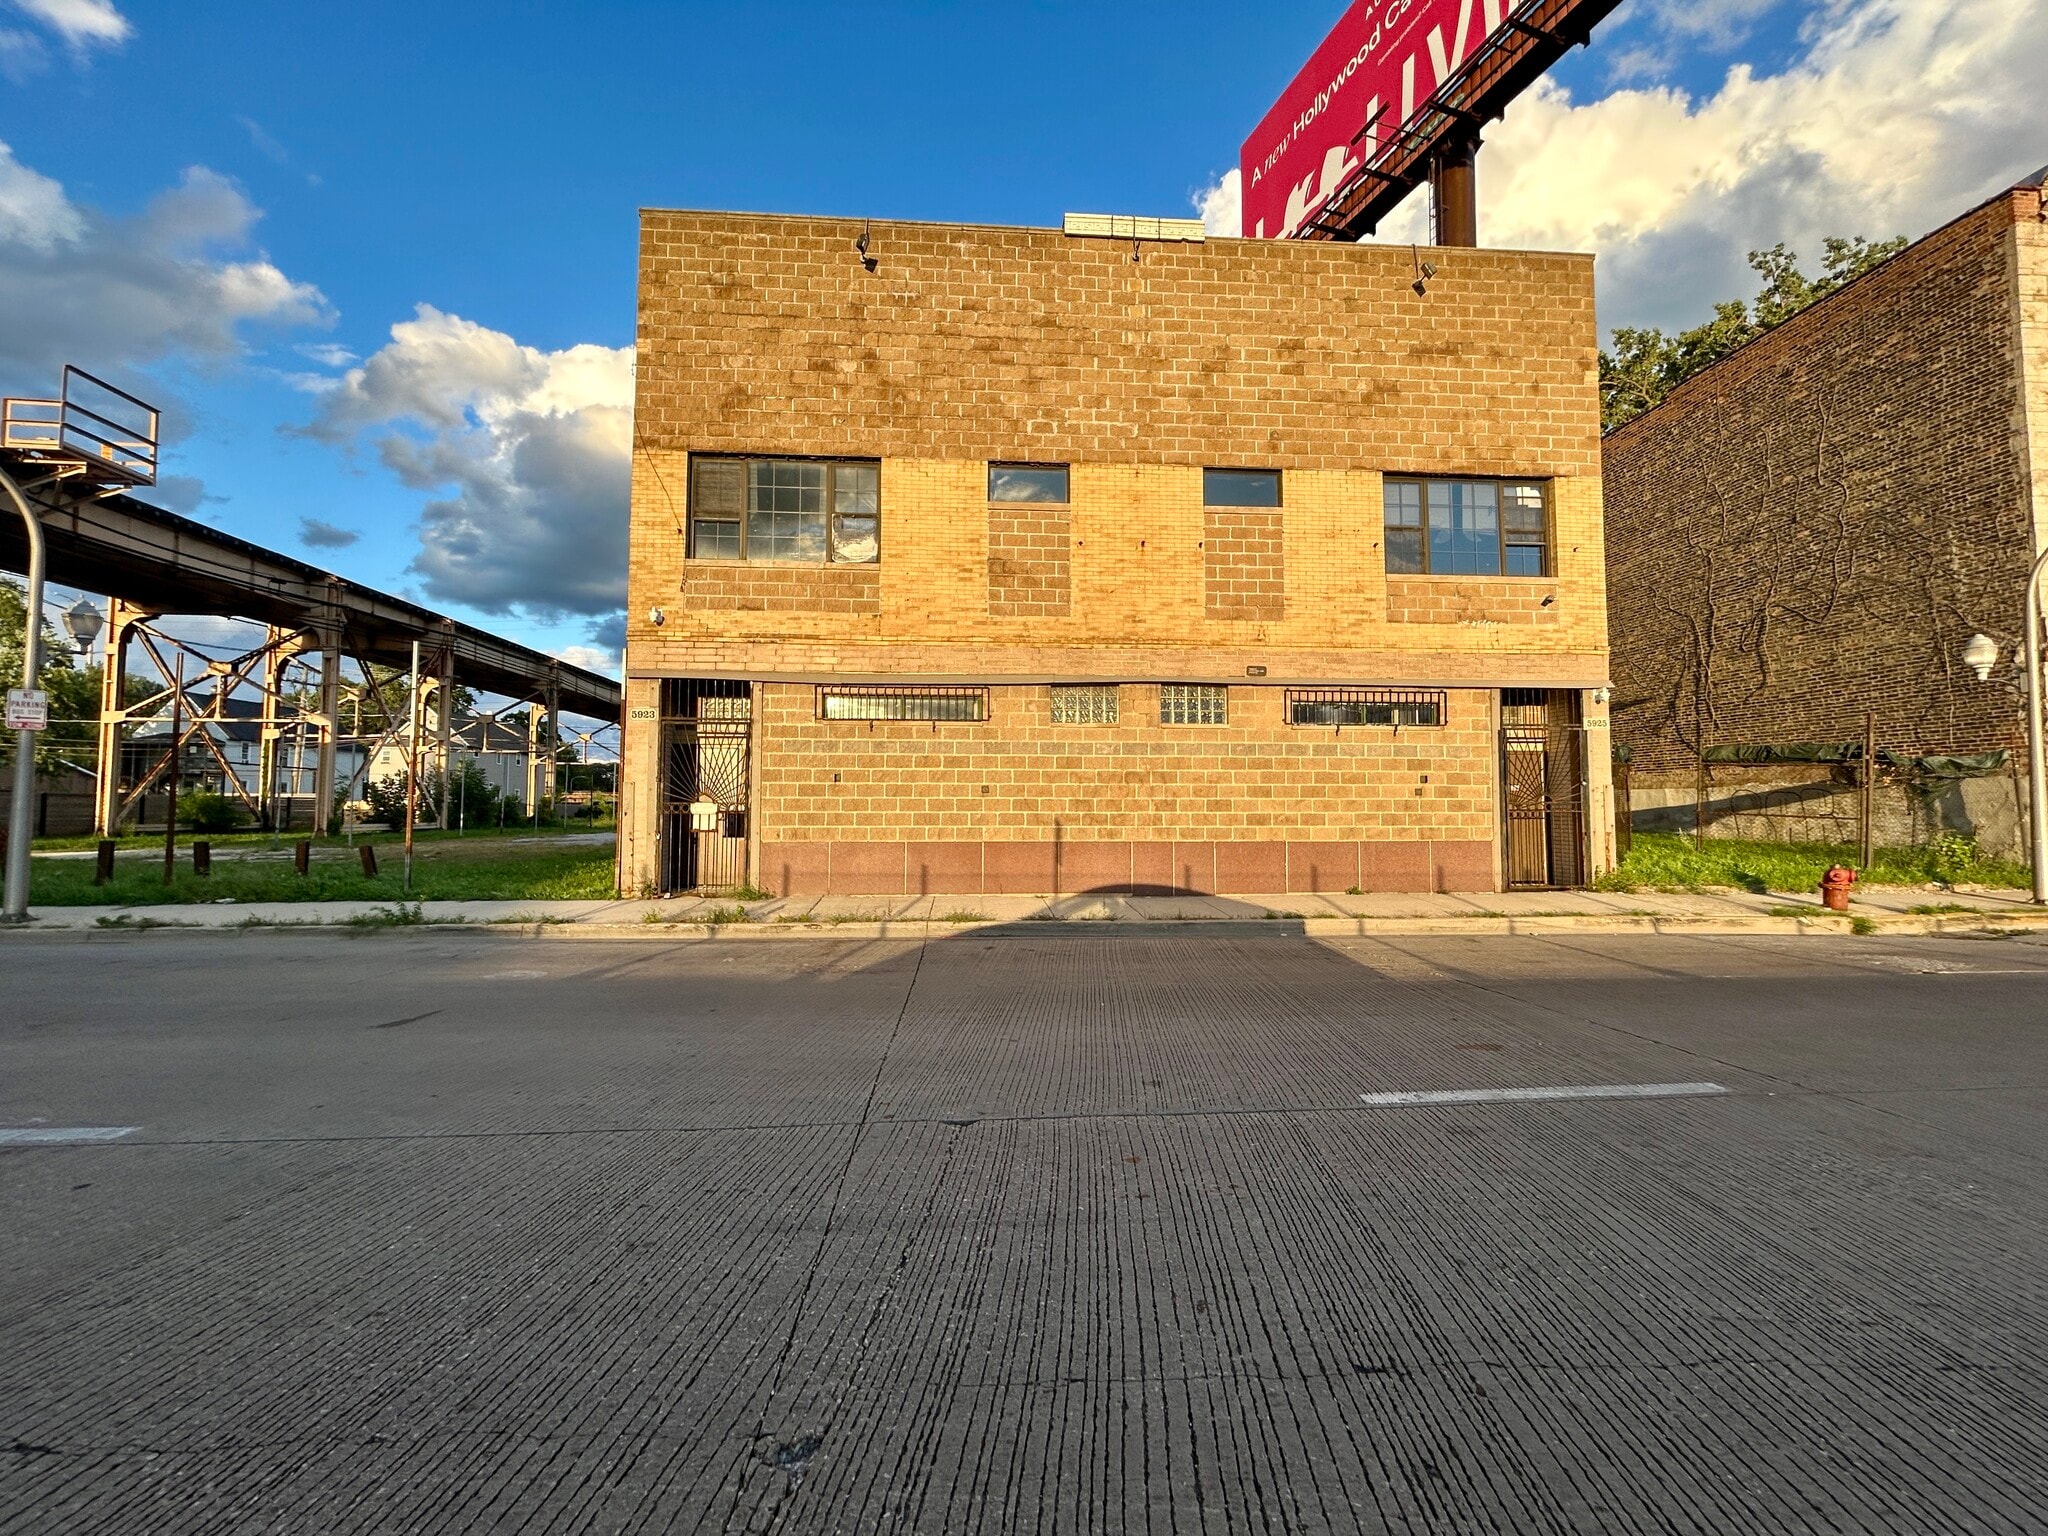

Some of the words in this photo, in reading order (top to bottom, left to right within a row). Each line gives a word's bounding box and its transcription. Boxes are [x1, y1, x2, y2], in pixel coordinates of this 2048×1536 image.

[1251, 166, 1262, 189] A
[1264, 133, 1290, 174] new
[1293, 21, 1380, 140] Hollywood
[9, 700, 45, 709] PARKING
[631, 711, 655, 719] 5923
[1587, 719, 1607, 727] 5925
